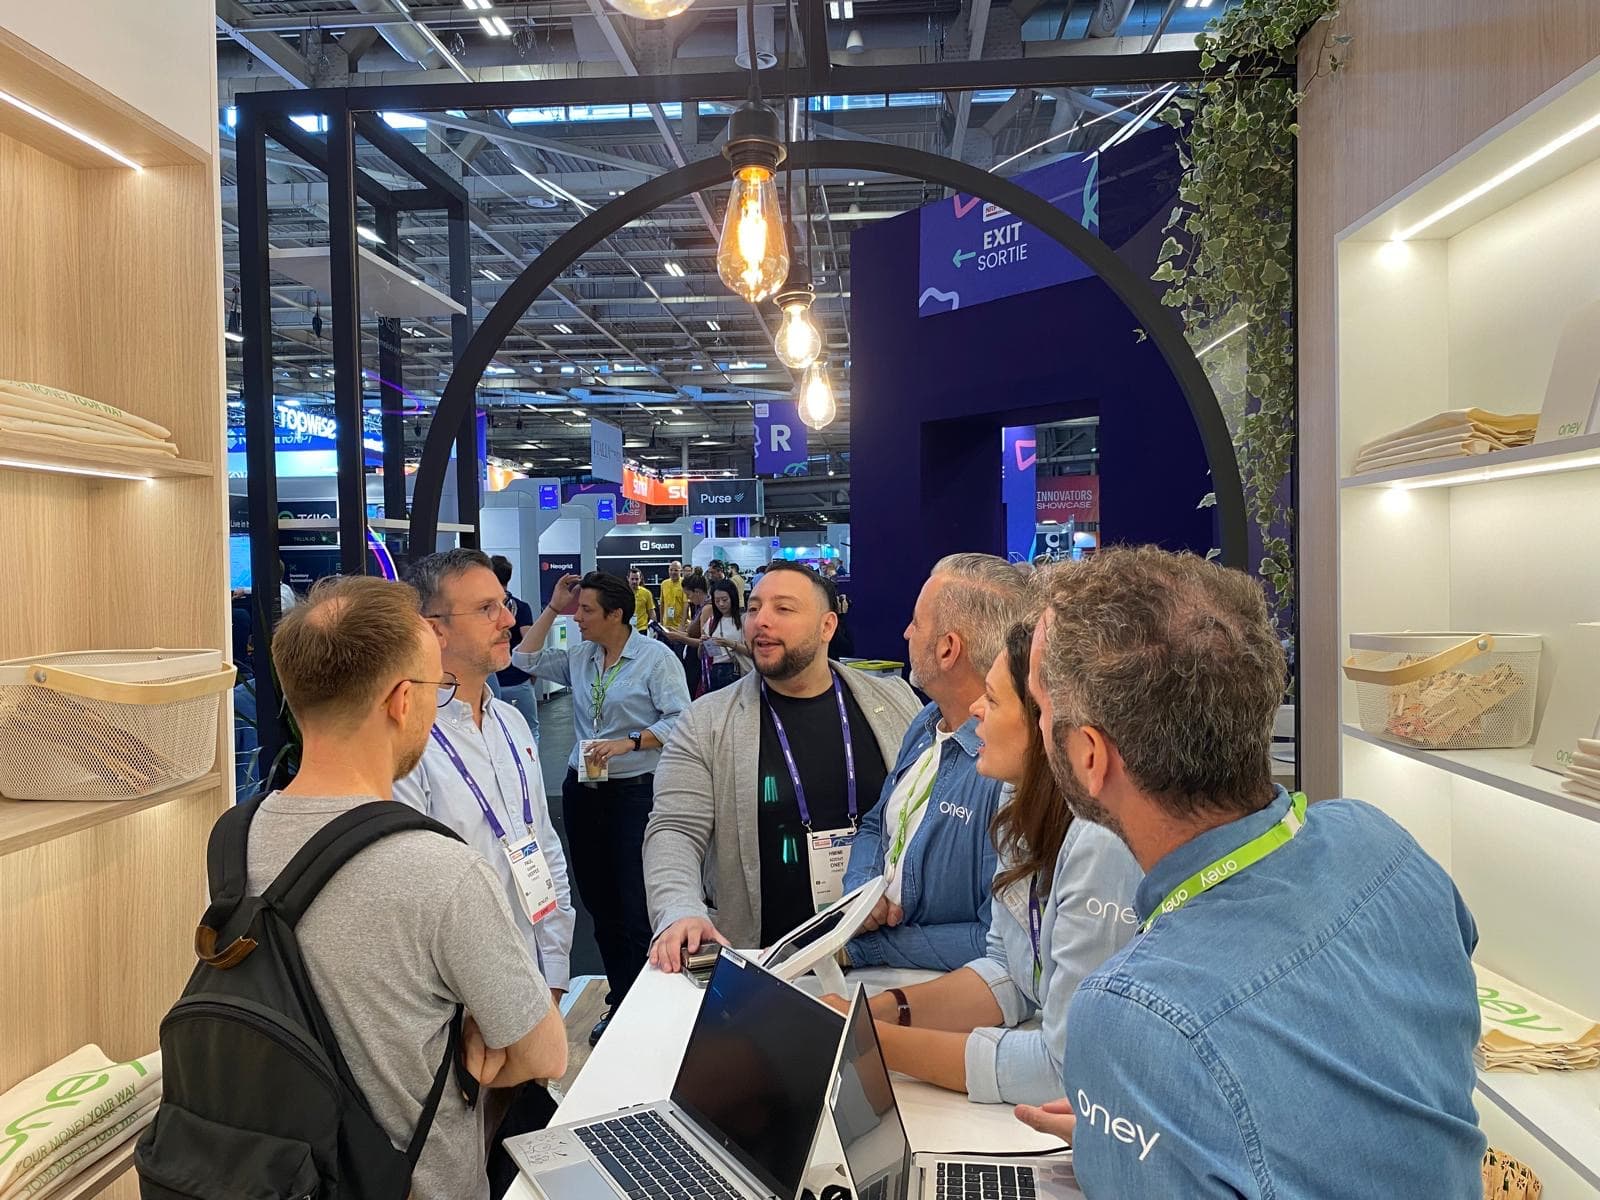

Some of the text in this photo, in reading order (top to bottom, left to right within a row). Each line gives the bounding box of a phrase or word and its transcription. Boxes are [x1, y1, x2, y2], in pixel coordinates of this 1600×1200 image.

[983, 222, 1022, 250] EXIT
[977, 243, 1028, 271] SORTIE
[770, 424, 792, 452] R
[700, 493, 732, 504] Purse
[1036, 490, 1092, 502] INNOVATORS
[1036, 501, 1092, 510] SHOWCASE
[650, 542, 675, 551] Square
[1557, 749, 1573, 763] one
[940, 801, 973, 825] oney
[1200, 859, 1238, 887] oney
[1086, 897, 1137, 924] one
[15, 1144, 49, 1173] YOUR
[49, 1119, 88, 1151] MONEY
[88, 1098, 115, 1121] YOUR
[115, 1080, 137, 1104] WAY
[1077, 1088, 1160, 1160] oney
